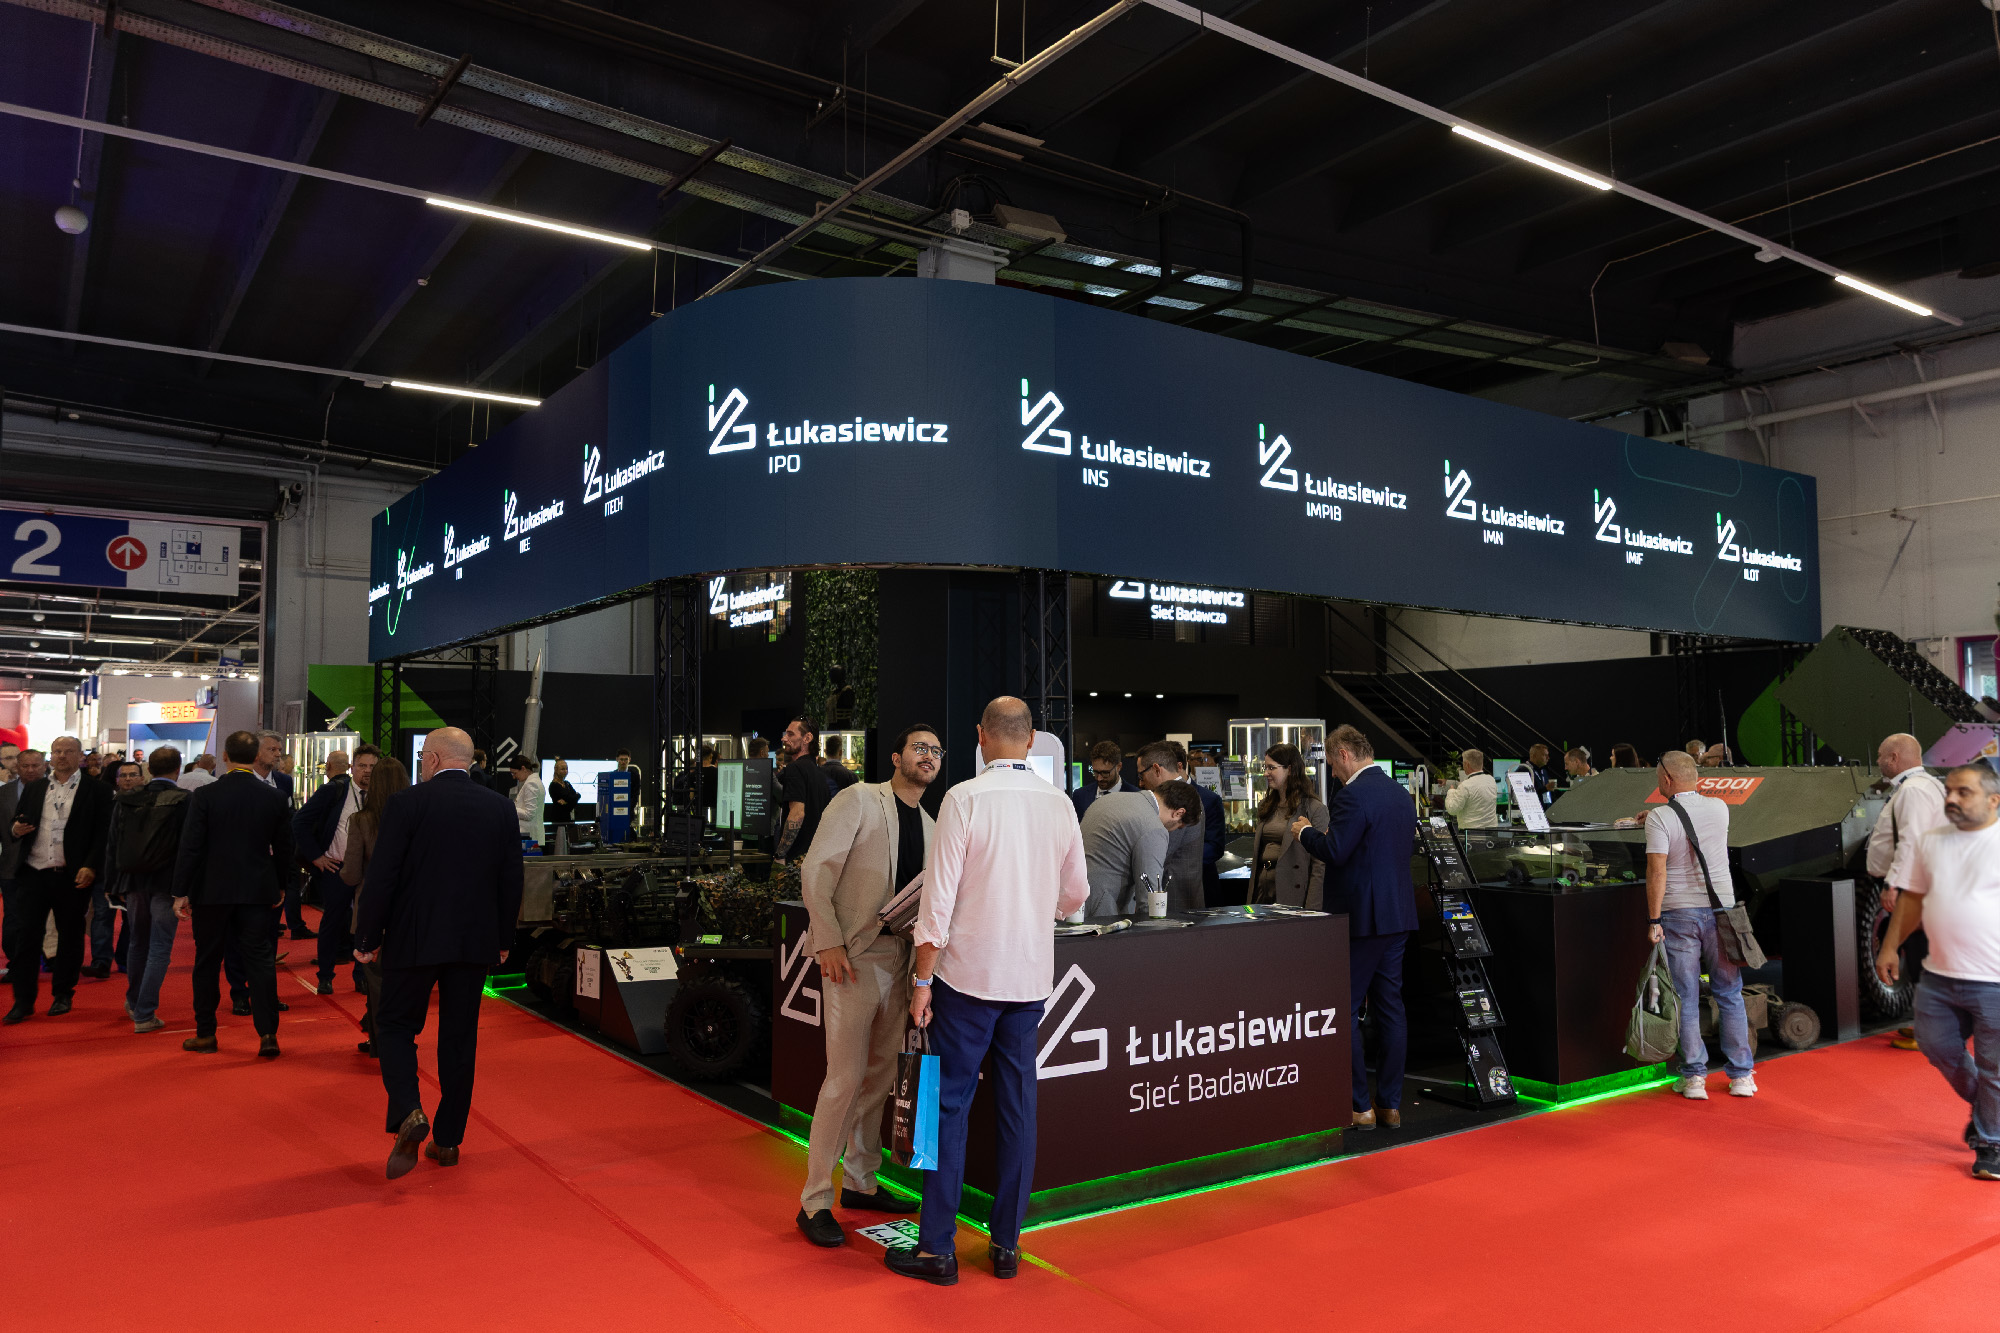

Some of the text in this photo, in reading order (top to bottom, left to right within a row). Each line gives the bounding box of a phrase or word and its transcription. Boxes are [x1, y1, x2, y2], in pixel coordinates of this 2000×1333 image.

[766, 416, 949, 447] Łukasiewicz
[605, 450, 665, 494] Łukasiewicz
[768, 454, 801, 474] IPO
[1080, 435, 1211, 478] Łukasiewicz
[1082, 467, 1109, 488] INS
[1304, 472, 1407, 510] Łukasiewicz
[520, 499, 564, 534] Łukasiewicz
[604, 495, 624, 517] ITECH
[1481, 503, 1565, 535] Łukasiewicz
[11, 519, 62, 576] 2
[1483, 529, 1504, 546] IMN
[1624, 527, 1694, 555] Łukasiewicz
[1742, 546, 1802, 572] Łukasiewicz
[1149, 583, 1245, 608] Łukasiewicz
[1151, 604, 1228, 624] Sieć Badawcza
[1125, 1002, 1337, 1066] Łukasiewicz
[1129, 1063, 1299, 1113] Sieć Badawcza
